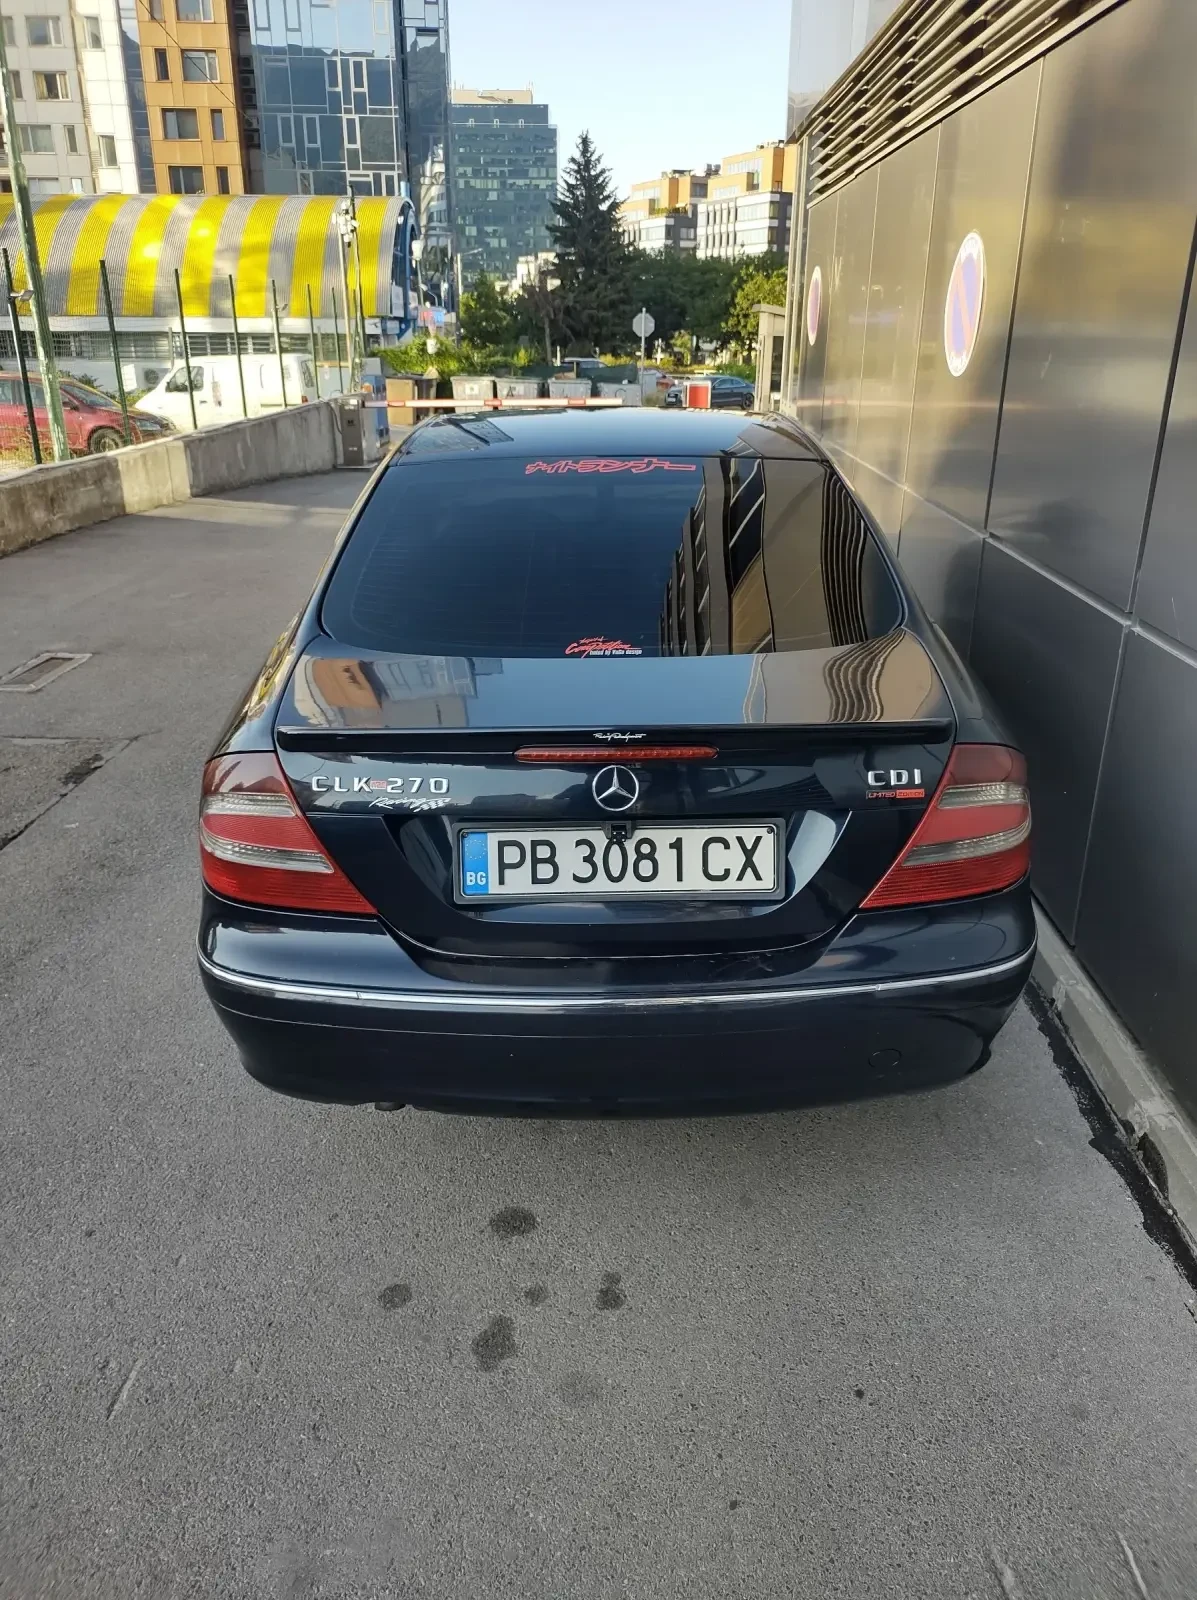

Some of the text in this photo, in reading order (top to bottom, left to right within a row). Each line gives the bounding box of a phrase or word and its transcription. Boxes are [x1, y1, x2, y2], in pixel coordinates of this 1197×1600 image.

[525, 457, 697, 474] ナイトランナー
[311, 776, 450, 794] CLK 270
[867, 768, 922, 786] CDI
[497, 835, 764, 886] PB 3081 CX
[465, 871, 487, 886] BG
